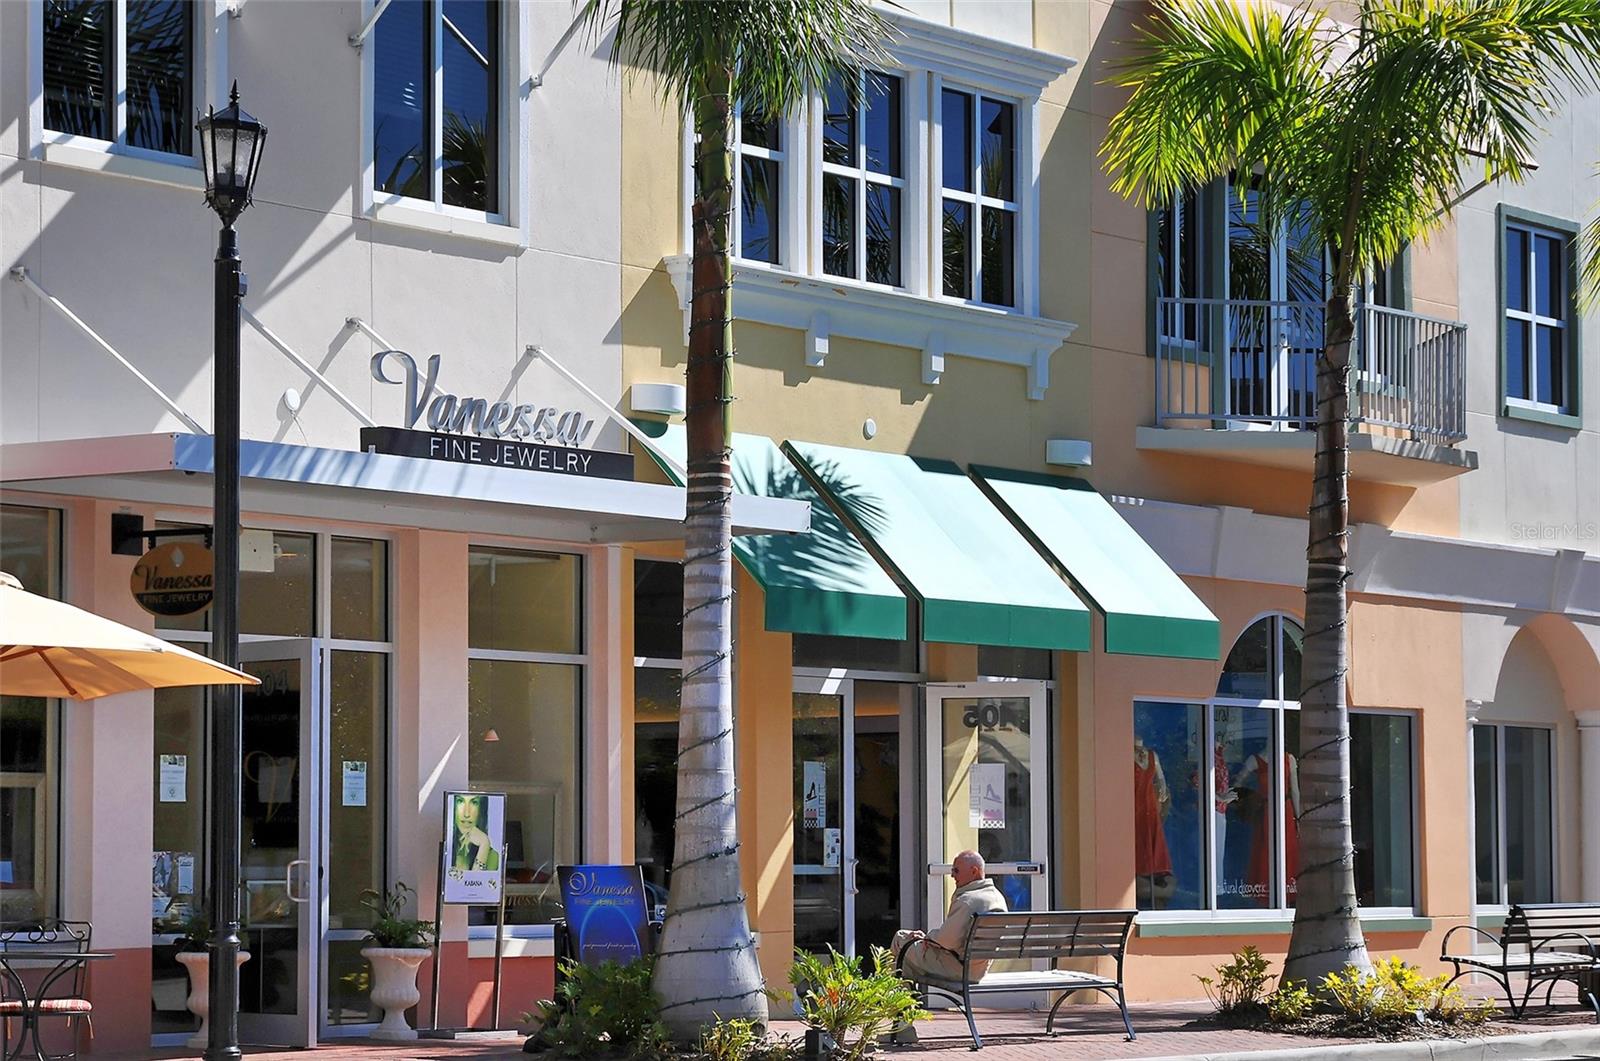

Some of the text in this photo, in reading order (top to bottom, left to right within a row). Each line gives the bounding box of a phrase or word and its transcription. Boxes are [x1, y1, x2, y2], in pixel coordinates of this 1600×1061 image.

[370, 350, 594, 445] Vanessa
[430, 437, 592, 473] FINE JEWELRY
[134, 565, 212, 590] Vanessa
[166, 592, 210, 603] JEWELRY
[569, 872, 634, 897] Vanessa
